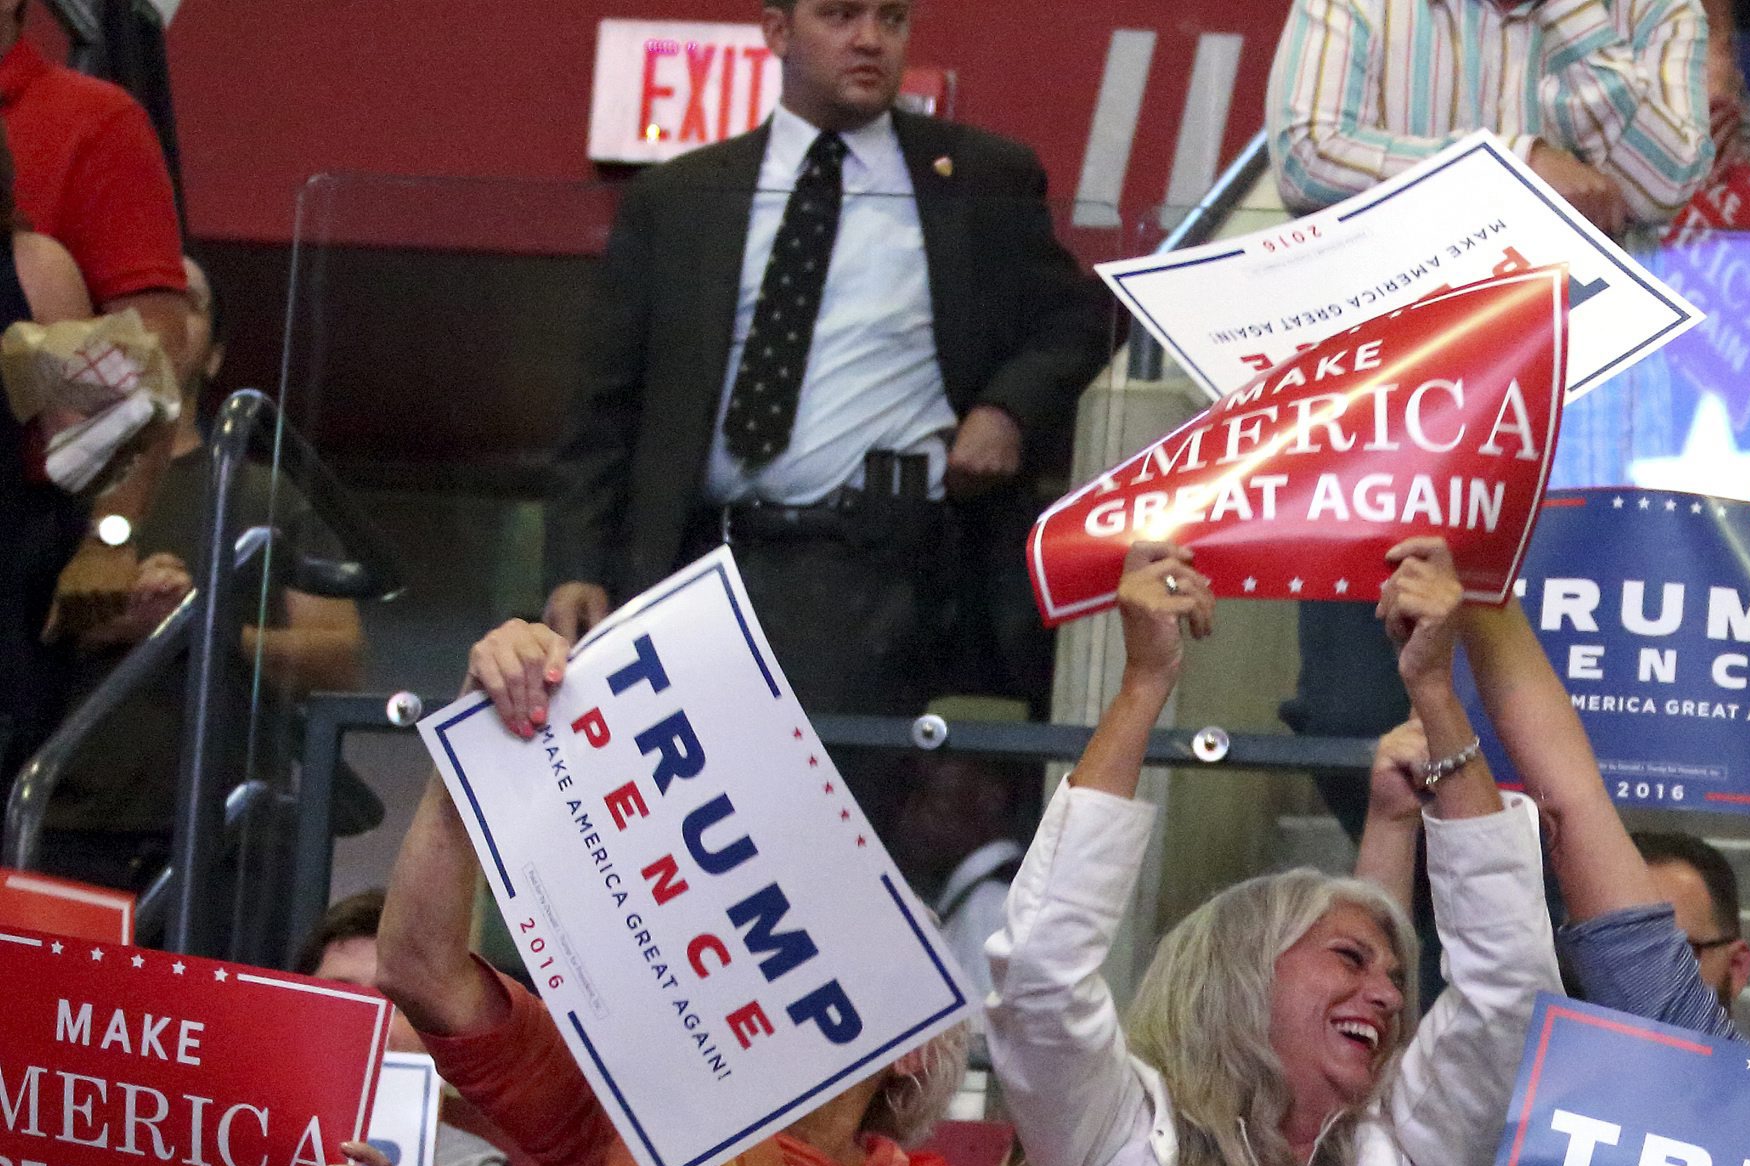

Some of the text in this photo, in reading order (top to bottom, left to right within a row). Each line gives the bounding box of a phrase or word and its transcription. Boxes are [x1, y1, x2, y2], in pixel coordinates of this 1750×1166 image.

[638, 43, 774, 143] EXIT
[1263, 223, 1323, 254] 2016
[1447, 219, 1507, 259] MAKE
[1349, 258, 1440, 308] AMERICA
[1282, 302, 1343, 332] GREAT
[1225, 340, 1384, 412] MAKE
[1097, 378, 1540, 496] MERICA
[1085, 473, 1504, 537] GREAT AGAIN
[1570, 694, 1656, 714] MERICA
[1666, 699, 1739, 720] GREAT
[1617, 781, 1684, 800] 2016
[606, 633, 863, 1046] TRUMP
[541, 724, 733, 1081] MAKE AMERICA GREAT AGAIN!
[571, 706, 775, 1050] PENCE
[520, 917, 564, 989] 2016
[56, 999, 205, 1066] MAKE
